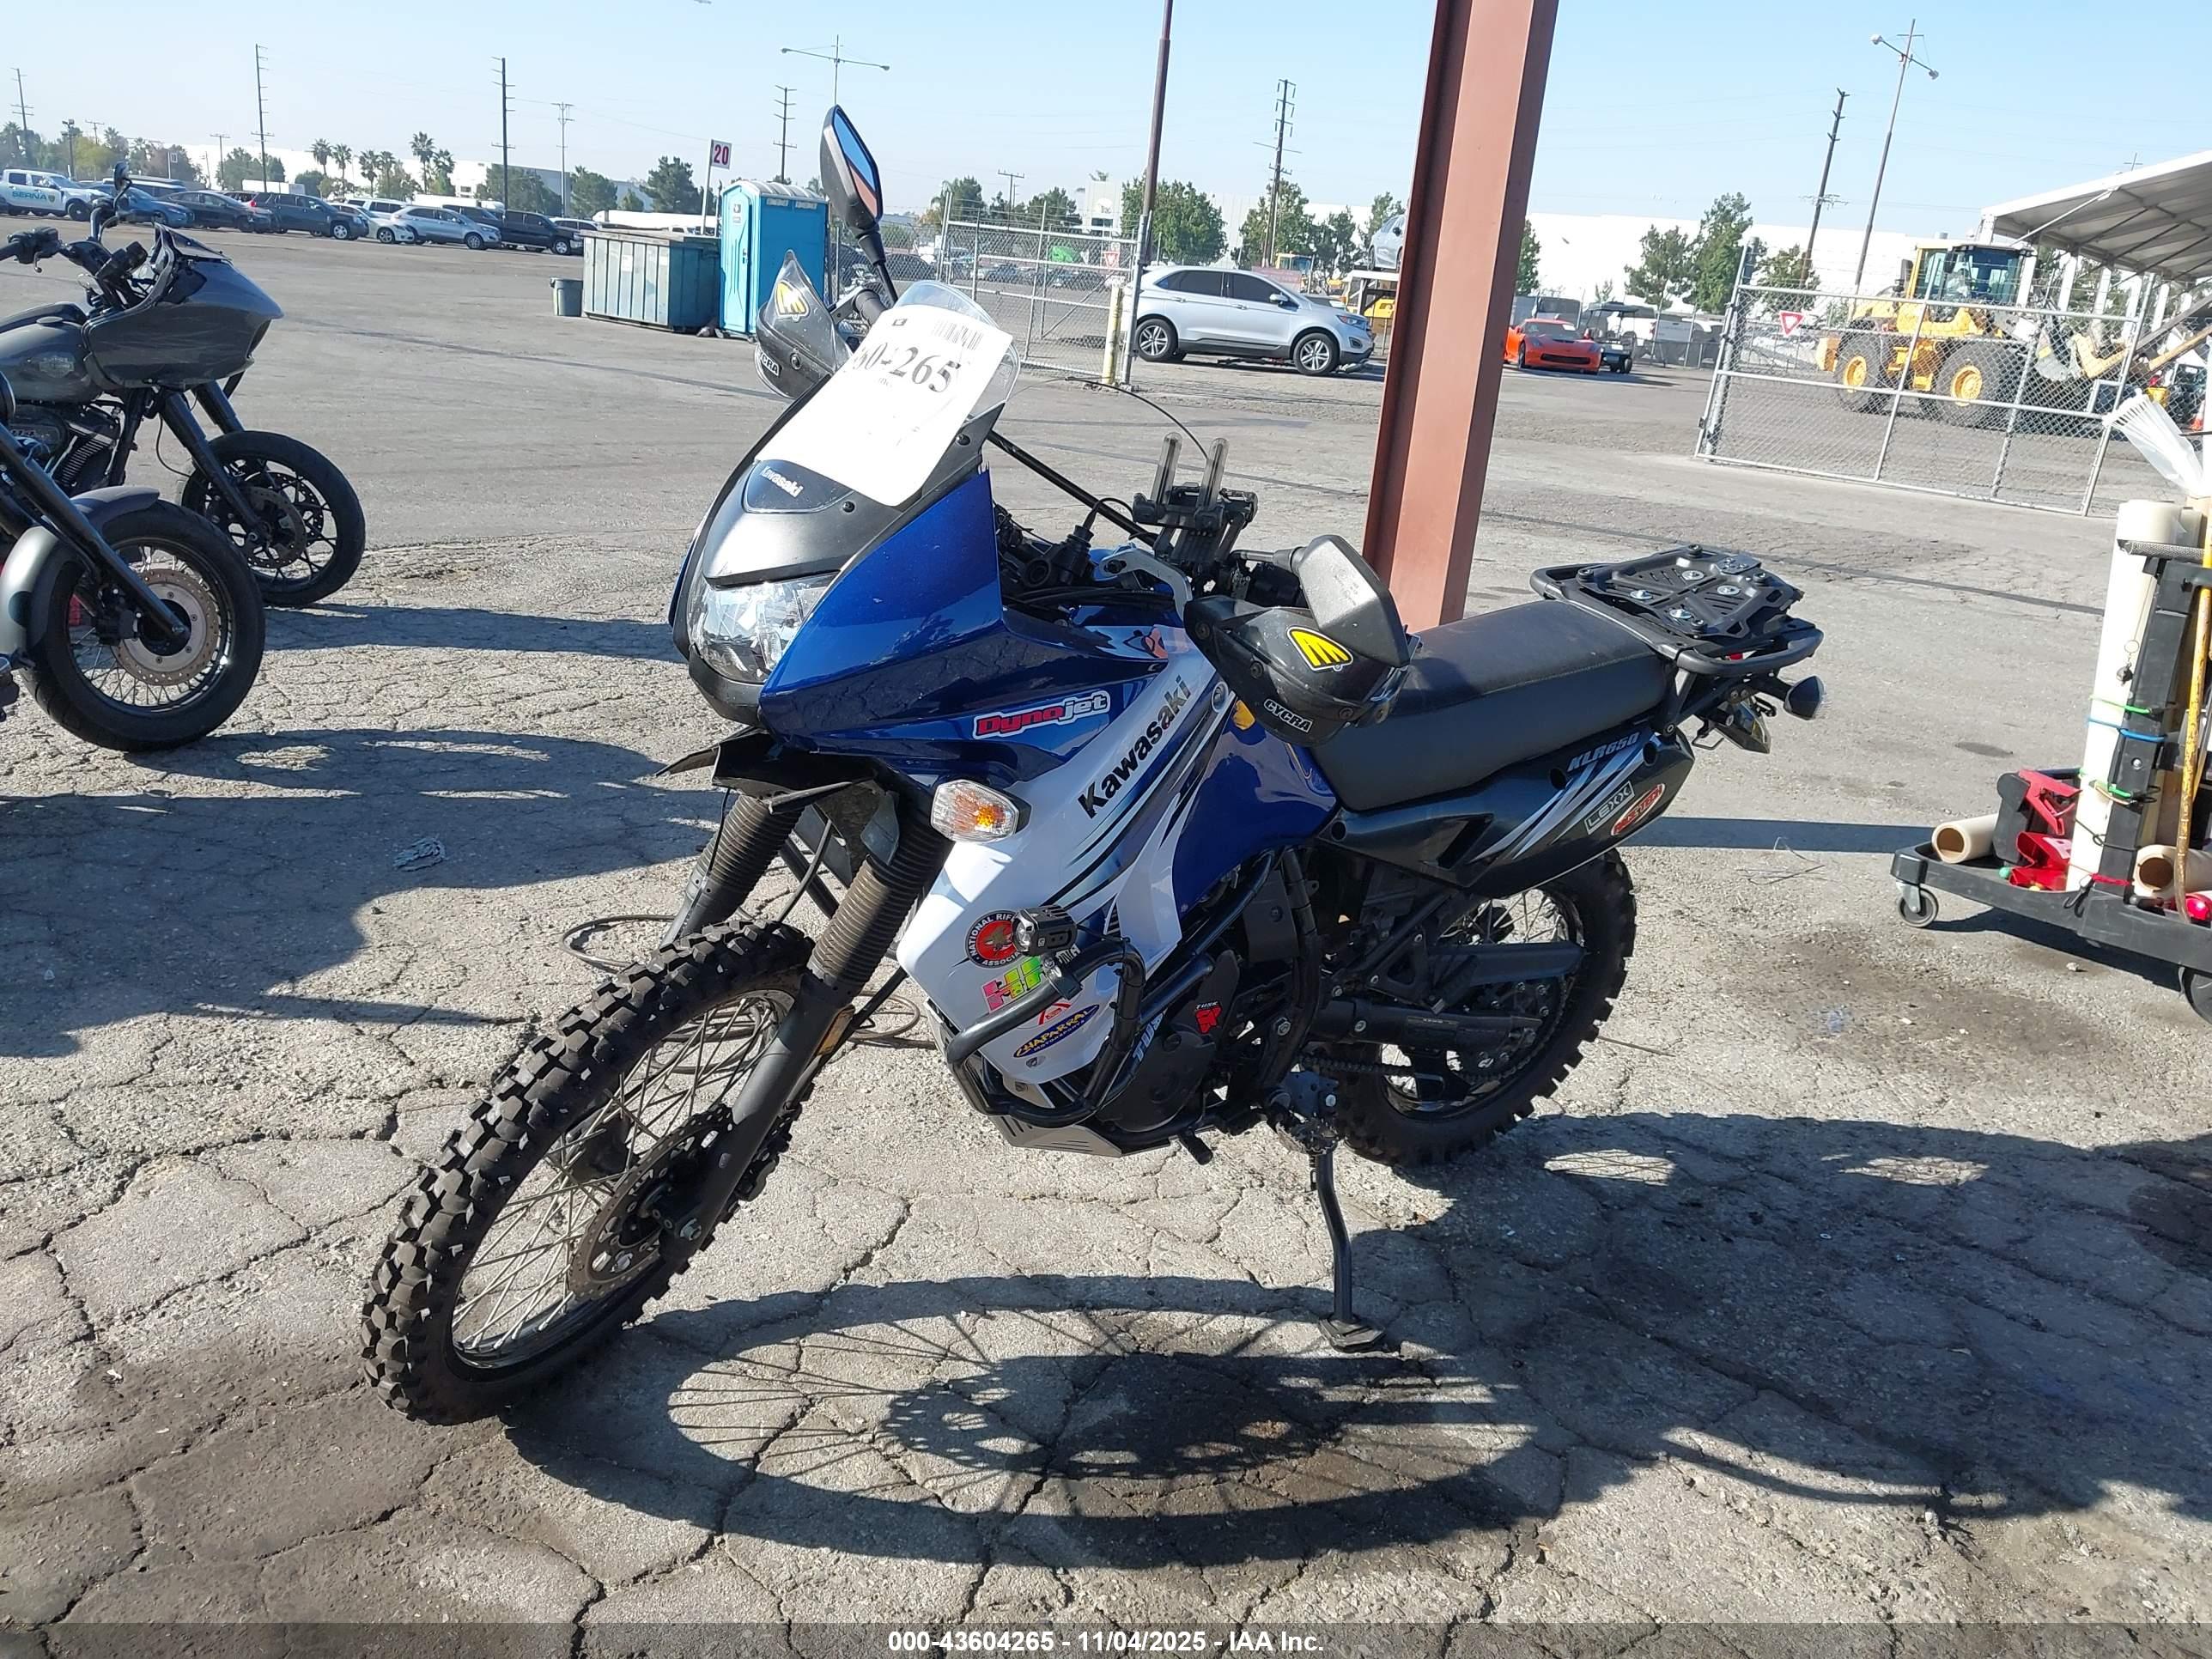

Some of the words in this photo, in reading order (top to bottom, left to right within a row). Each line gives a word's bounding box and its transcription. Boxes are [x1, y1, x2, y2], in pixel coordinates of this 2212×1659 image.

[714, 144, 729, 165] 20
[12, 191, 46, 200] SERNA
[760, 466, 804, 498] Kawasaki
[976, 694, 1108, 736] Dynojet
[1265, 700, 1312, 732] CYCRA
[1078, 674, 1191, 819] Kawasaki
[1567, 732, 1640, 772] KLR650
[1588, 787, 1632, 827] LEXX
[968, 916, 994, 957] NATIONAL
[1016, 1006, 1097, 1057] CHAPARRAL
